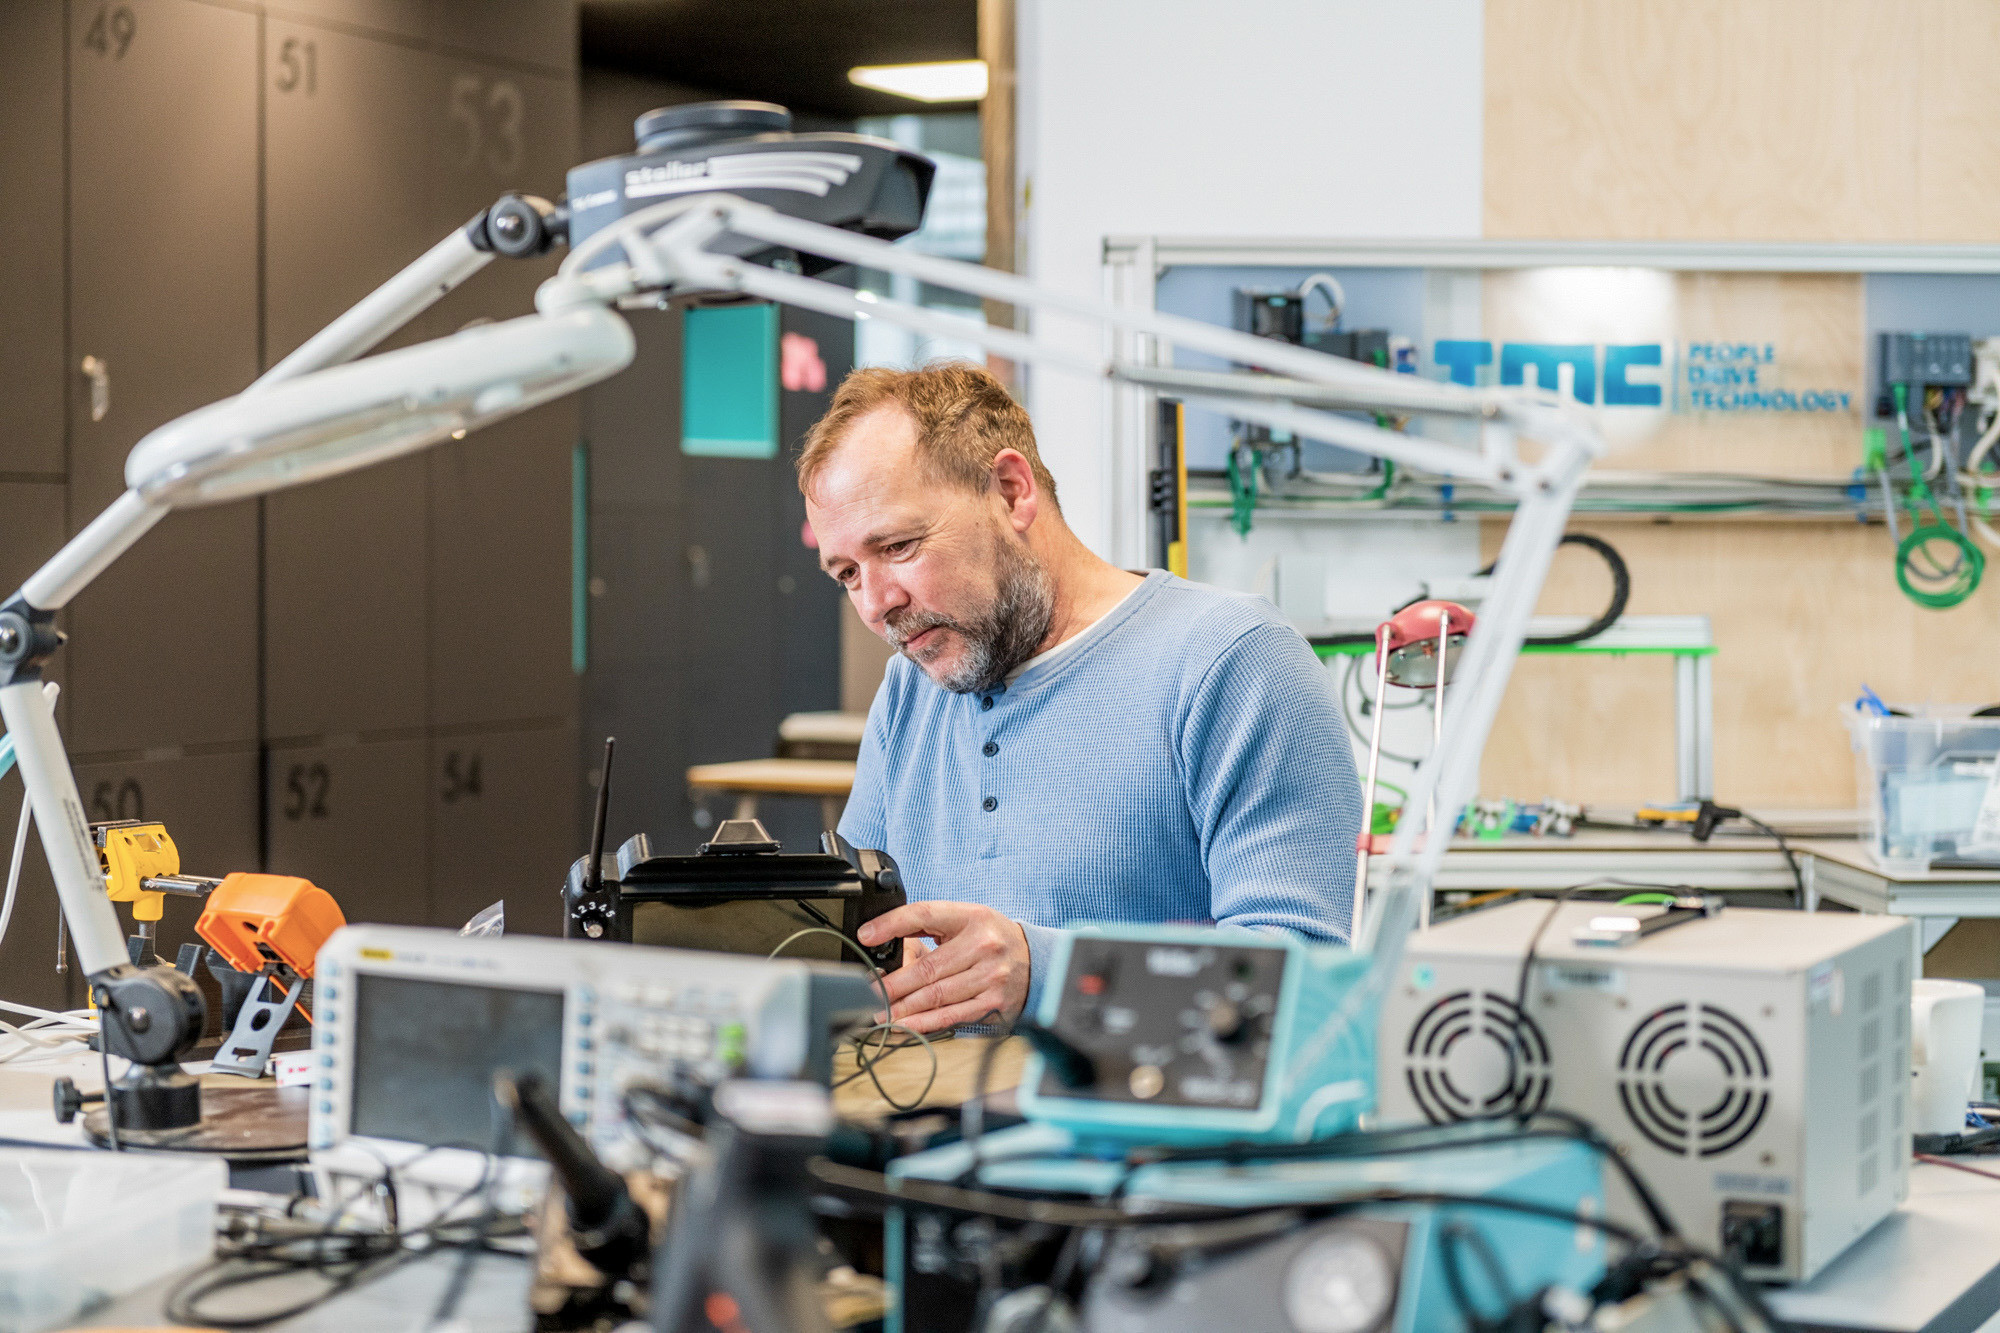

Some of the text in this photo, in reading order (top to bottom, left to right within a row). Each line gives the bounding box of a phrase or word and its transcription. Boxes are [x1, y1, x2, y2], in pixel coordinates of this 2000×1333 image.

[82, 5, 137, 60] 49
[276, 39, 318, 95] 51
[450, 76, 523, 173] 53
[1435, 341, 1661, 405] TMC
[1688, 343, 1775, 364] PEOPLE
[1688, 365, 1758, 385] DRIVE
[1690, 389, 1851, 412] TECHNOLOGY
[284, 762, 330, 820] 52
[442, 750, 482, 801] 54
[578, 905, 587, 914] 2
[589, 901, 597, 910] 3
[605, 910, 616, 918] 5
